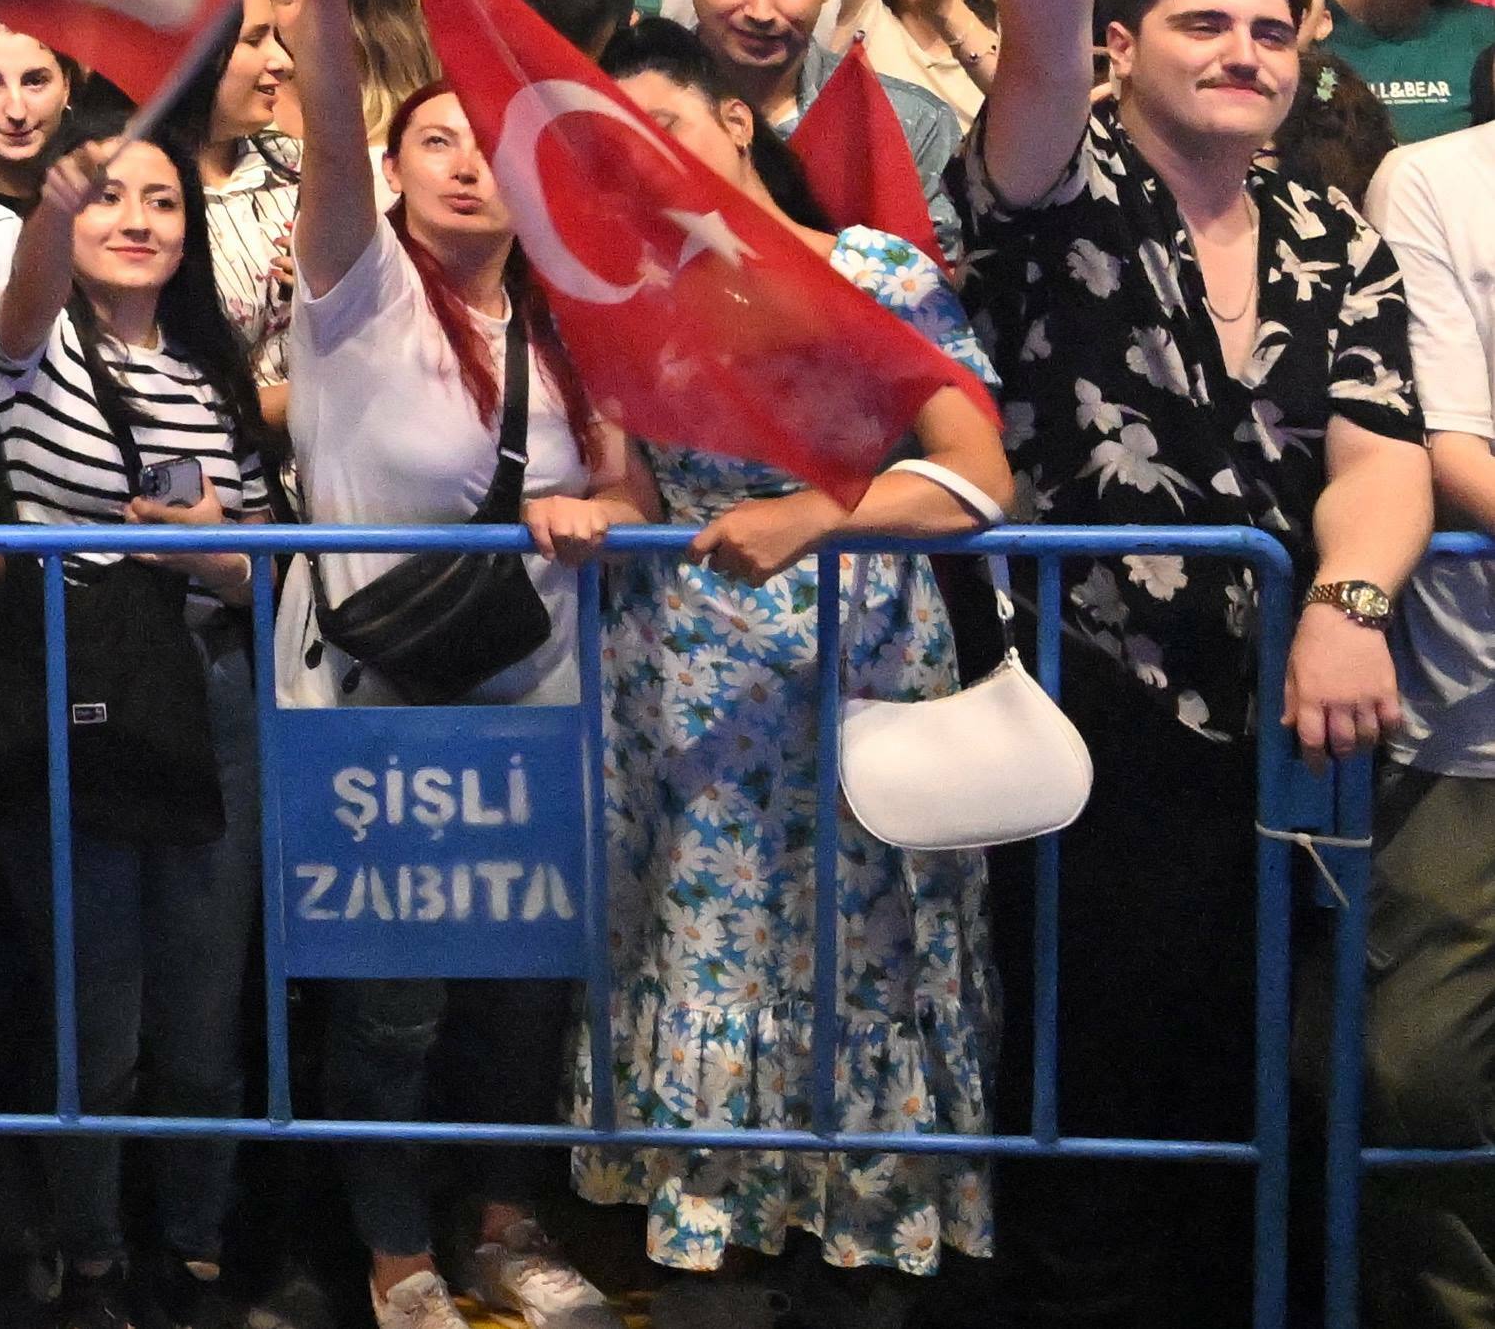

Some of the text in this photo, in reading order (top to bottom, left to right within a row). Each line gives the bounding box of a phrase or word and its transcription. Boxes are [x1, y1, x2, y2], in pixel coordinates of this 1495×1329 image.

[1366, 80, 1452, 100] LL&BEAR
[331, 752, 531, 843] ŞİŞLİ
[295, 860, 576, 923] ZABITA
